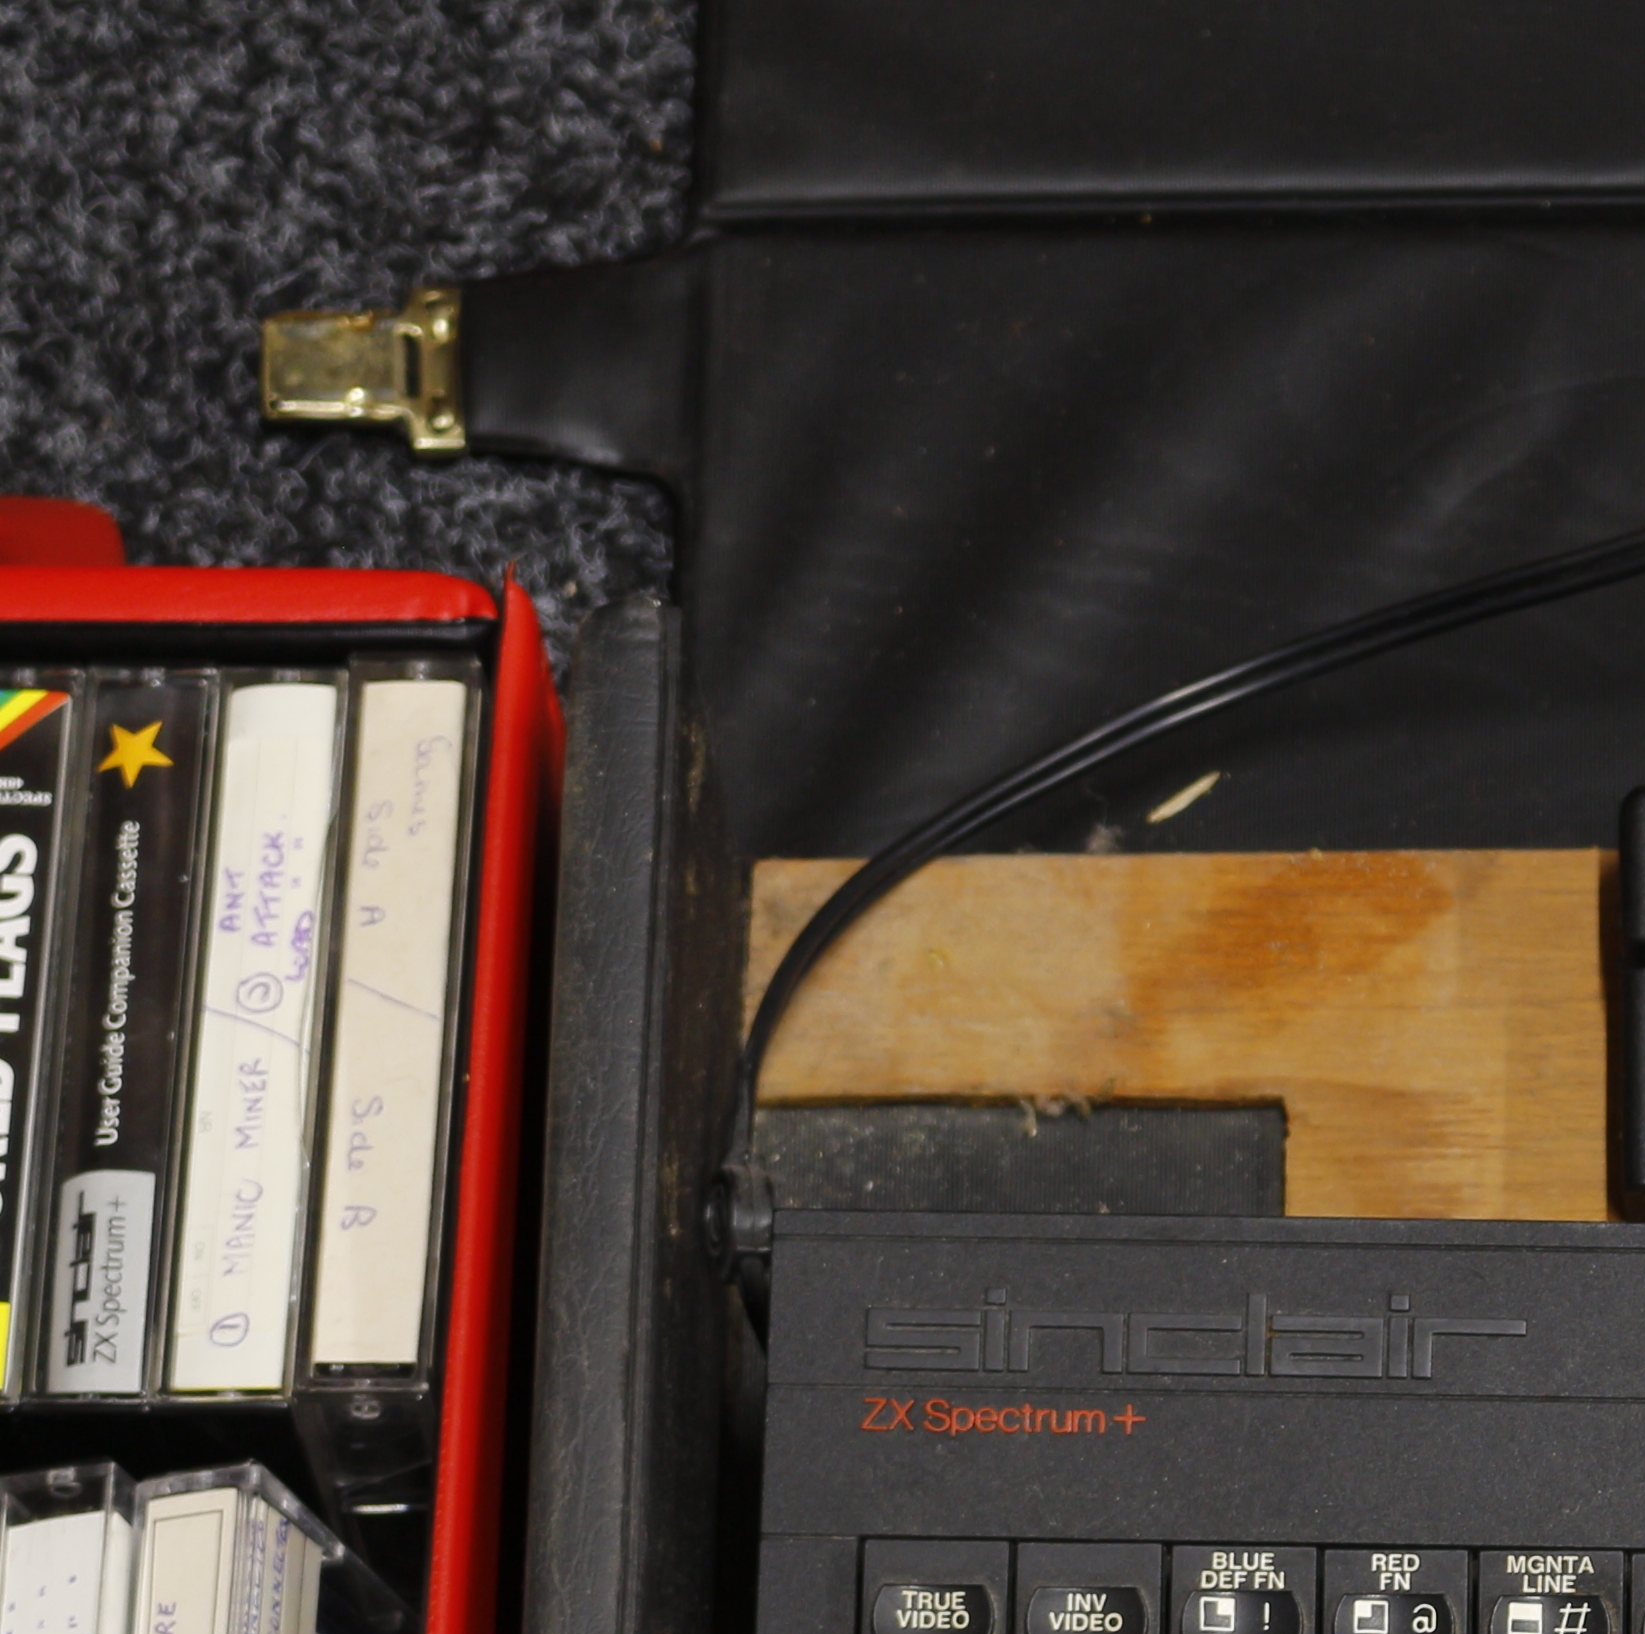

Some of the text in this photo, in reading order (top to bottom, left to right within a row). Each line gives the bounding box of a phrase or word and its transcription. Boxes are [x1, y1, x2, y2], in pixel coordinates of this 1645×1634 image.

[217, 866, 245, 933] ANT
[359, 905, 387, 927] A
[94, 820, 141, 1147] User Guide Companion Cassette
[234, 1056, 268, 1150] MINER
[341, 1095, 385, 1232] Side B
[221, 1178, 265, 1278] MANIC
[65, 1190, 96, 1367] sinclair
[93, 1332, 119, 1364] ZX
[864, 1287, 1527, 1380] sinclair
[860, 1398, 913, 1433] ZX
[1212, 1551, 1275, 1571] BLUE
[1371, 1553, 1420, 1572] RED
[1506, 1555, 1595, 1574] MGNTA
[901, 1589, 966, 1611] TRUE
[1066, 1592, 1107, 1612] INV
[896, 1609, 970, 1629] VIDEO
[1048, 1611, 1123, 1632] VIDEO
